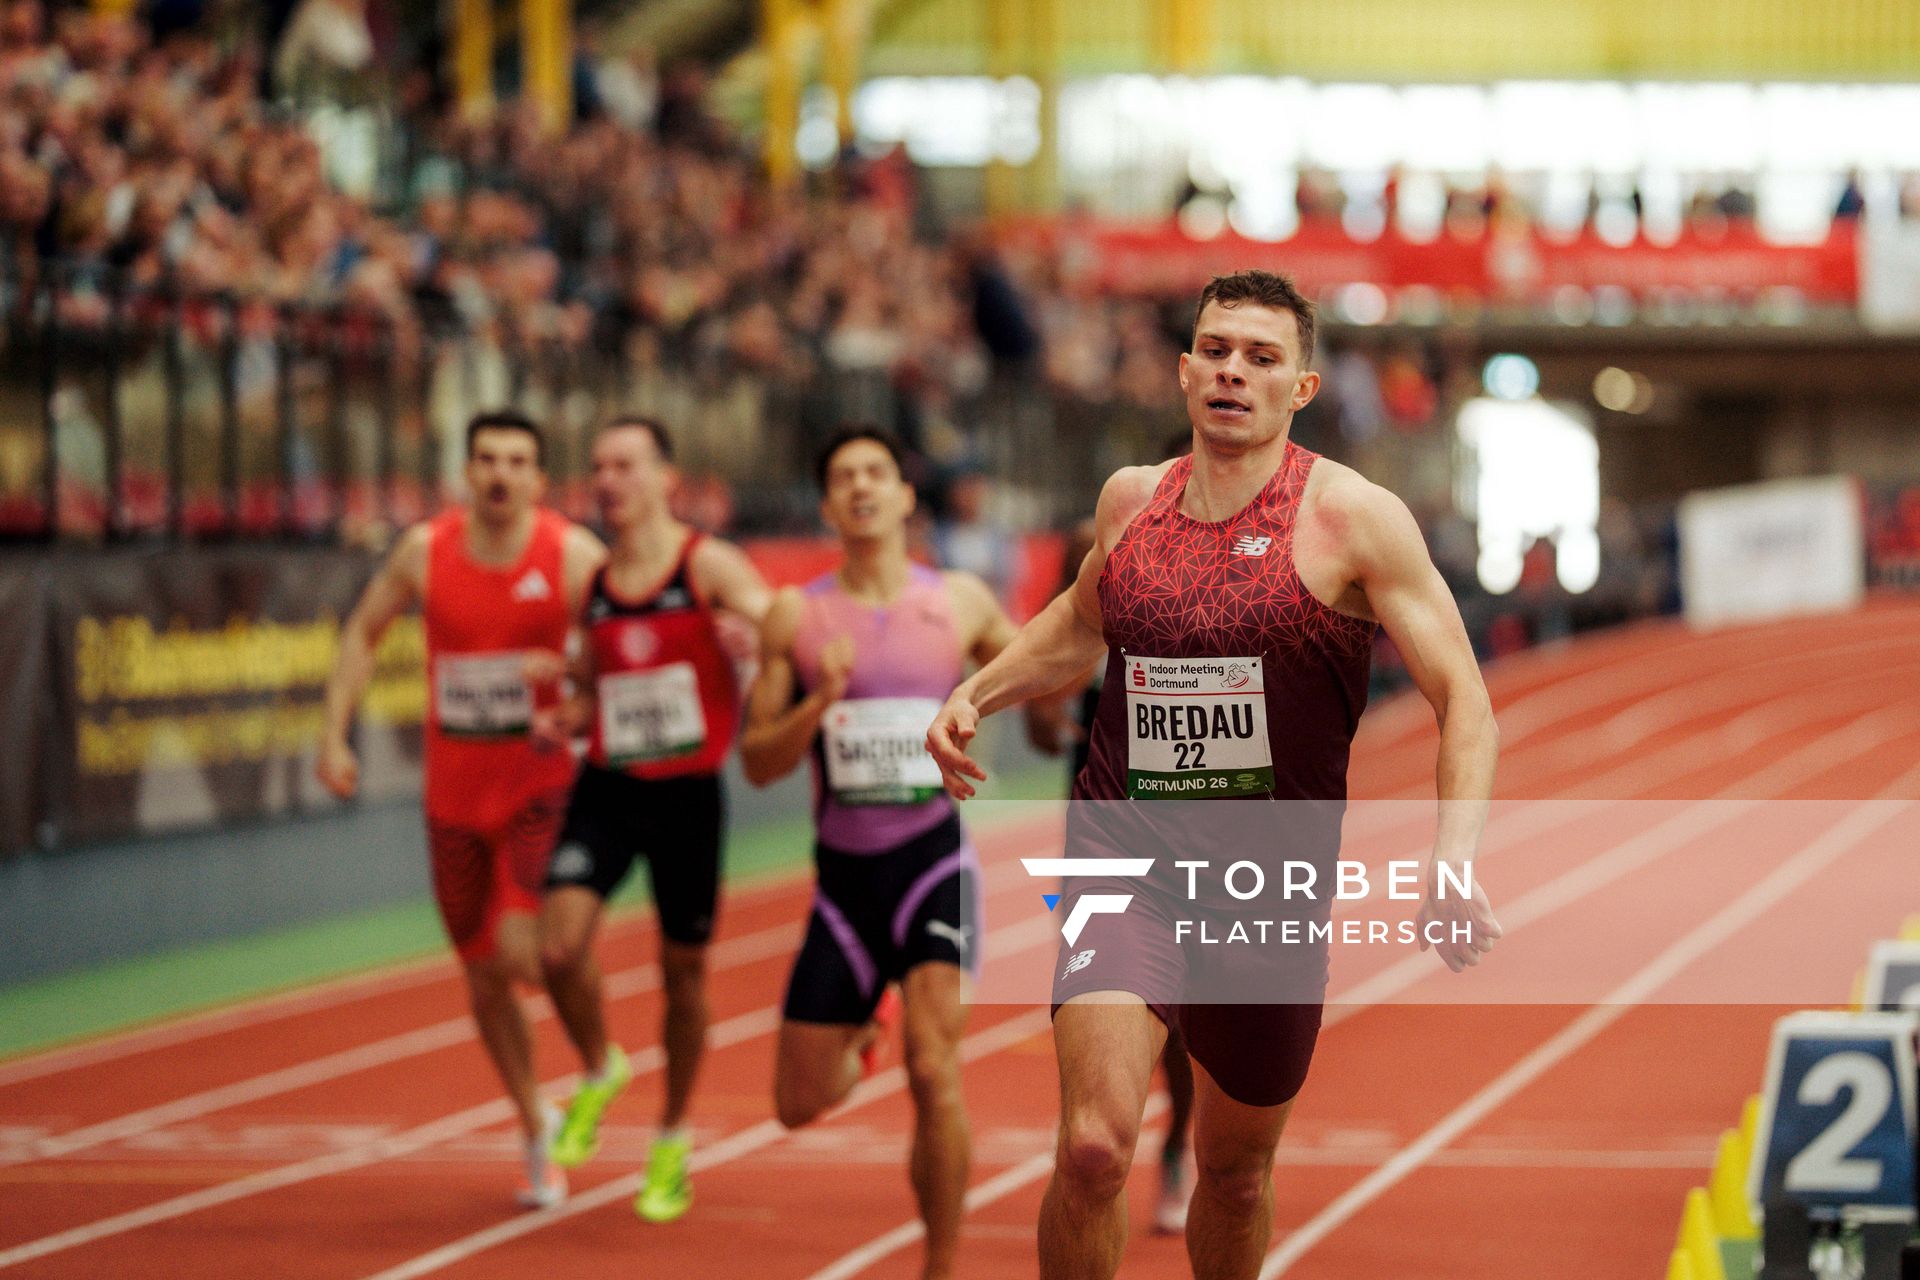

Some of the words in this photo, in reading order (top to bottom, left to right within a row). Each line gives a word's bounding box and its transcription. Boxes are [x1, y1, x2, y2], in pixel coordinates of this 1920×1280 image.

[1149, 664, 1178, 674] Indoor
[1180, 664, 1225, 676] Meeting
[1150, 678, 1199, 688] Dortmund
[1136, 703, 1254, 740] BREDAU
[1174, 742, 1206, 770] 22
[1138, 778, 1206, 792] DORTMUND
[1209, 777, 1228, 788] 26
[1784, 1050, 1894, 1193] 2
